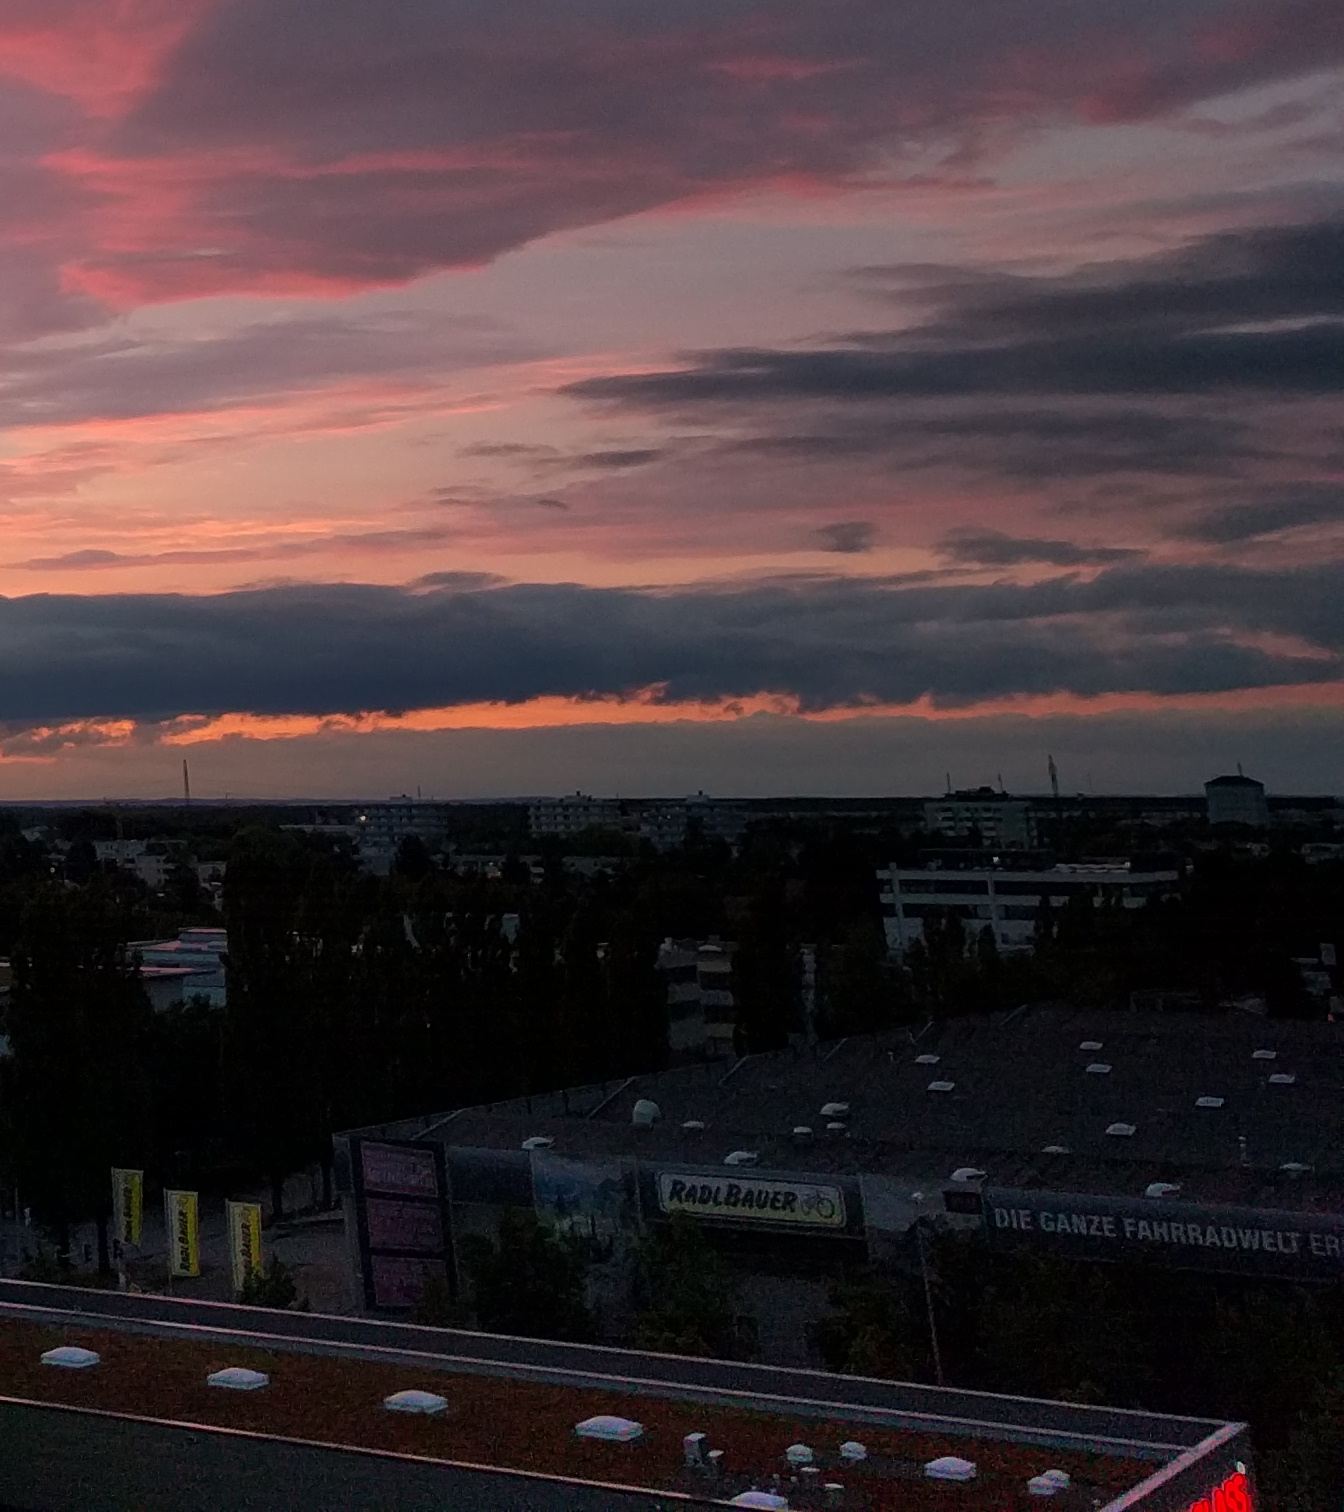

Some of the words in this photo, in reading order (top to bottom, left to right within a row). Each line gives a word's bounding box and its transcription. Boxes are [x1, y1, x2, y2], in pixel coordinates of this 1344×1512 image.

[669, 1179, 798, 1213] RADLBAUER
[995, 1207, 1035, 1231] DIE
[1039, 1210, 1117, 1238] GANZE
[1124, 1216, 1300, 1255] FAHRRADWELT
[1309, 1233, 1344, 1257] ER
